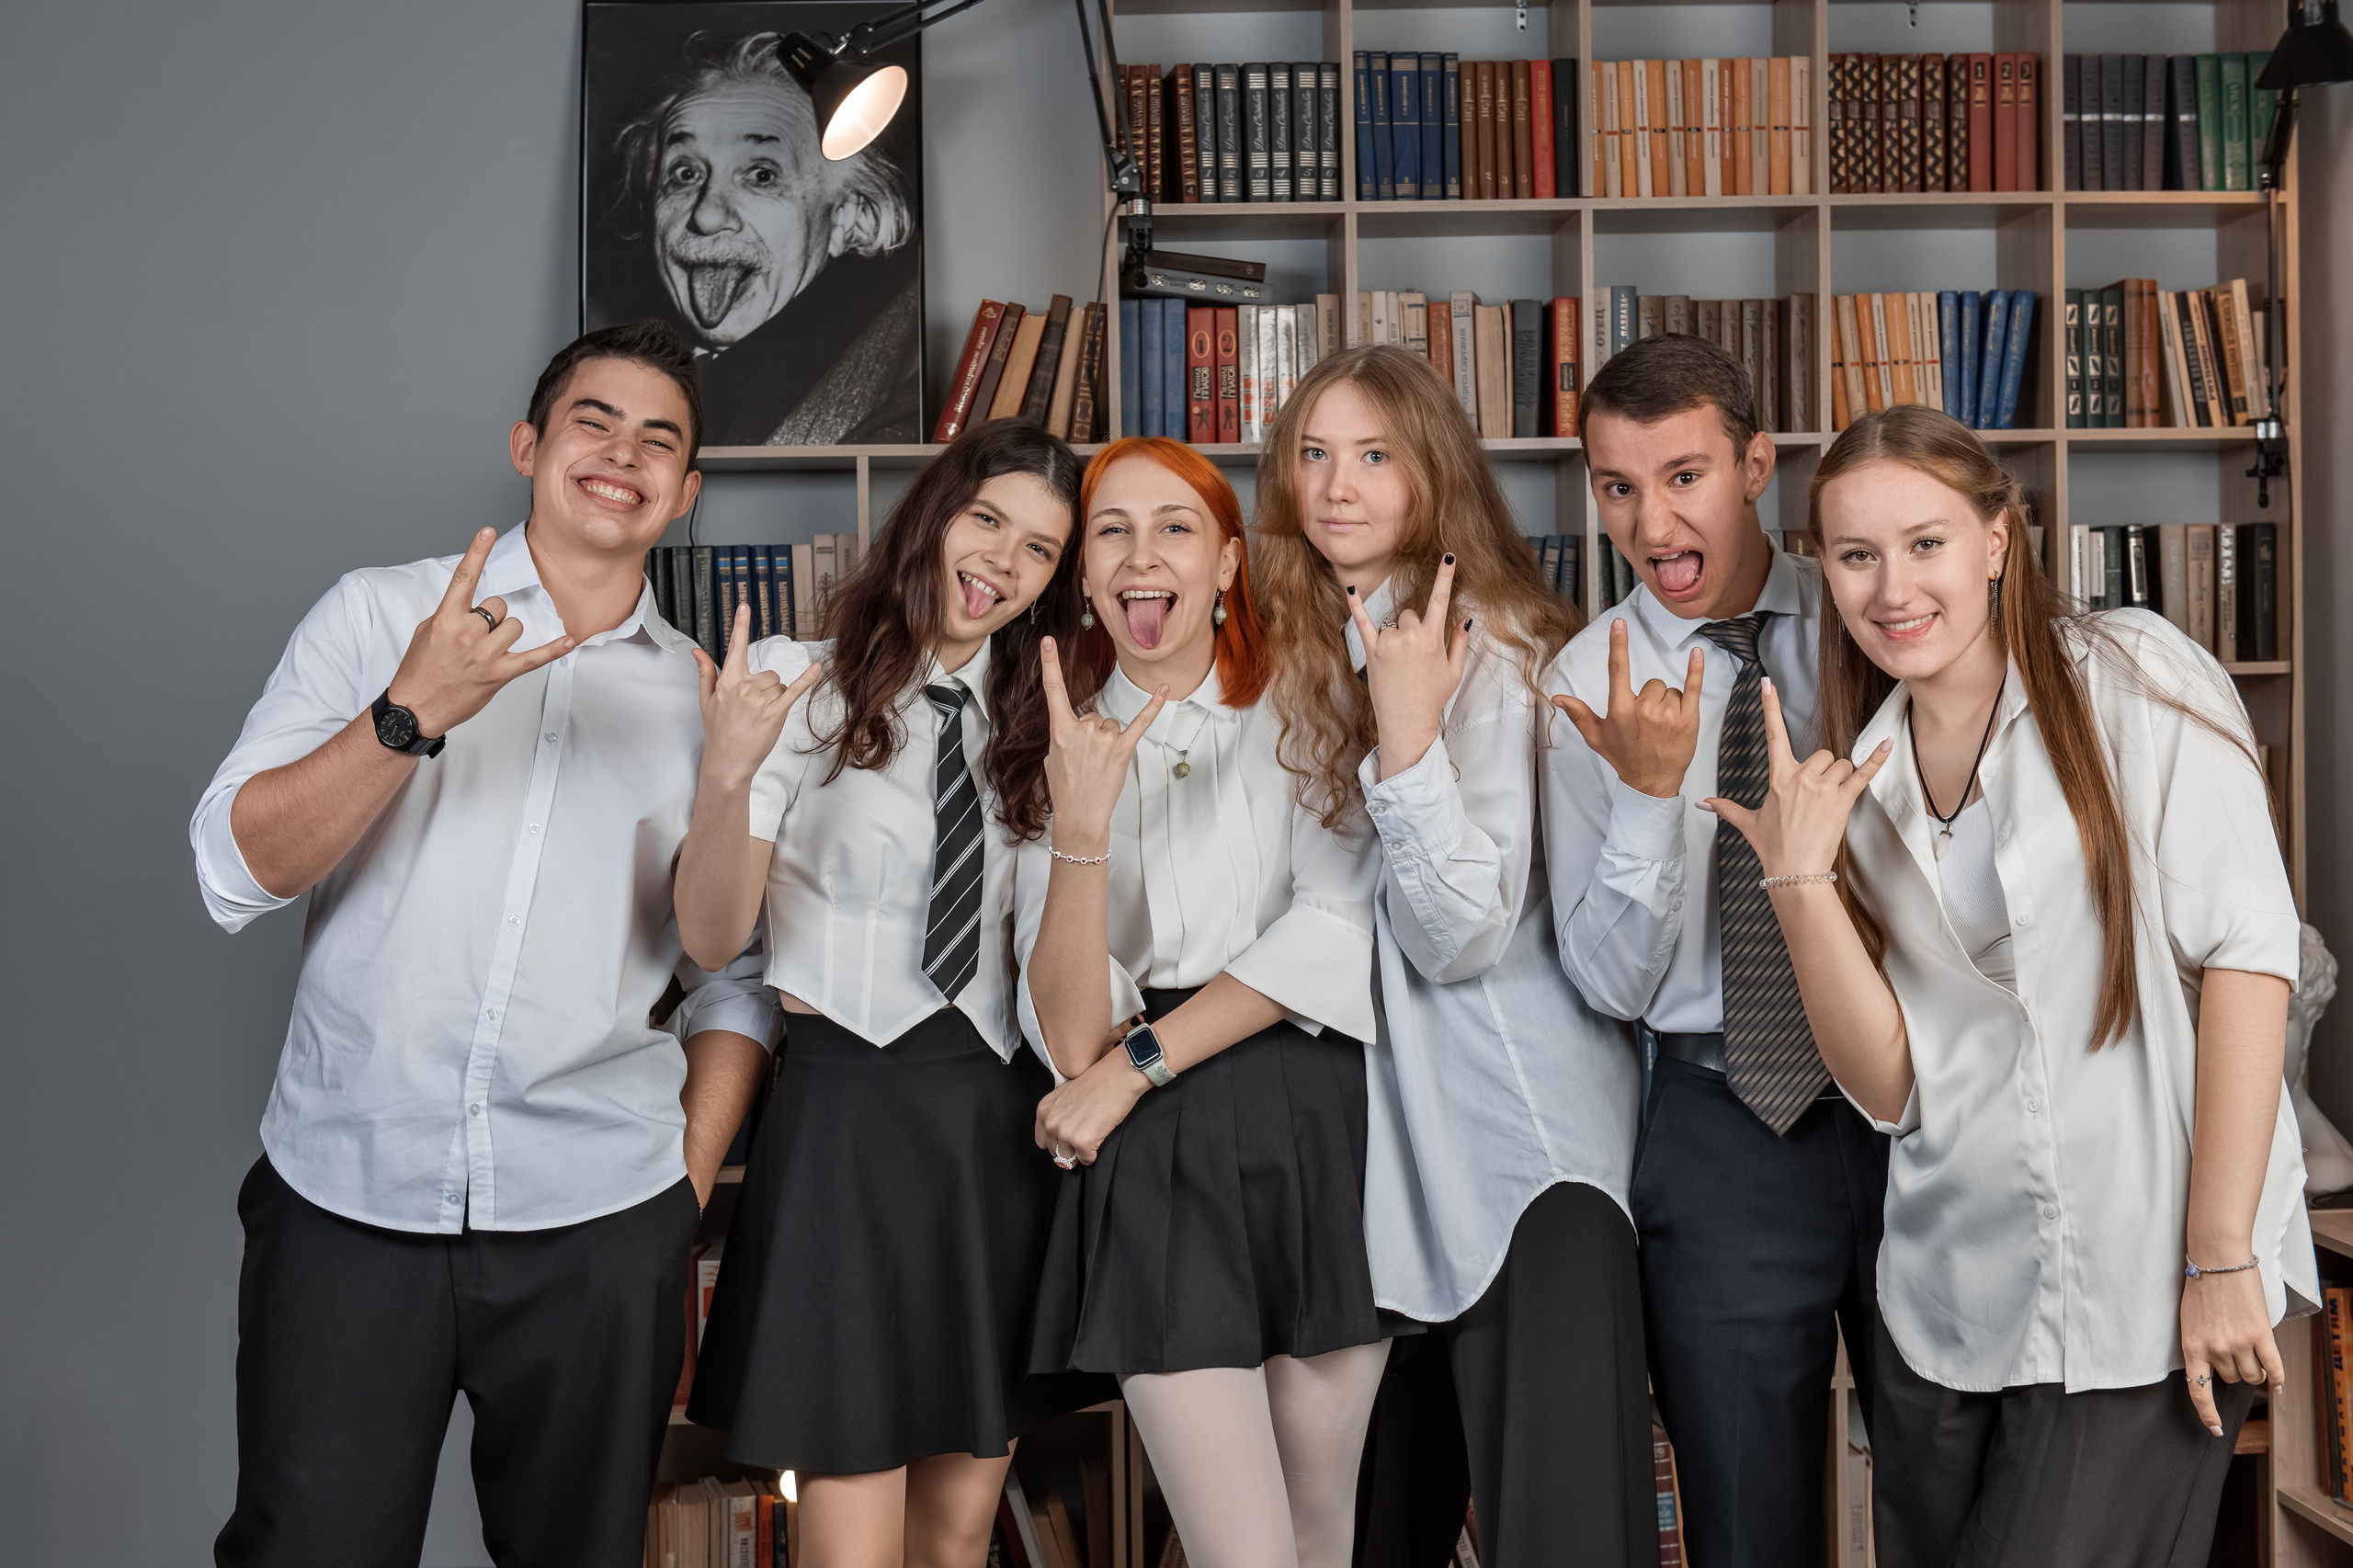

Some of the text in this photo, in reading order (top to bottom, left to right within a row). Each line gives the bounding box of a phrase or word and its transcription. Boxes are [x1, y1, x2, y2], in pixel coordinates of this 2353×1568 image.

[1977, 65, 1983, 77] 1
[2002, 64, 2010, 77] 2
[1303, 169, 1313, 177] 5
[1325, 169, 1333, 177] 6
[1674, 305, 1680, 313] 3
[1596, 309, 1606, 347] ОТЕЦ
[1222, 335, 1233, 353] 2
[1460, 328, 1468, 371] Сартаков
[954, 326, 987, 414] Международное право
[1228, 365, 1236, 398] ПЛАТОВ
[1201, 367, 1210, 399] ПЛАТОВ
[2328, 1297, 2344, 1371] ДЕТЯМ
